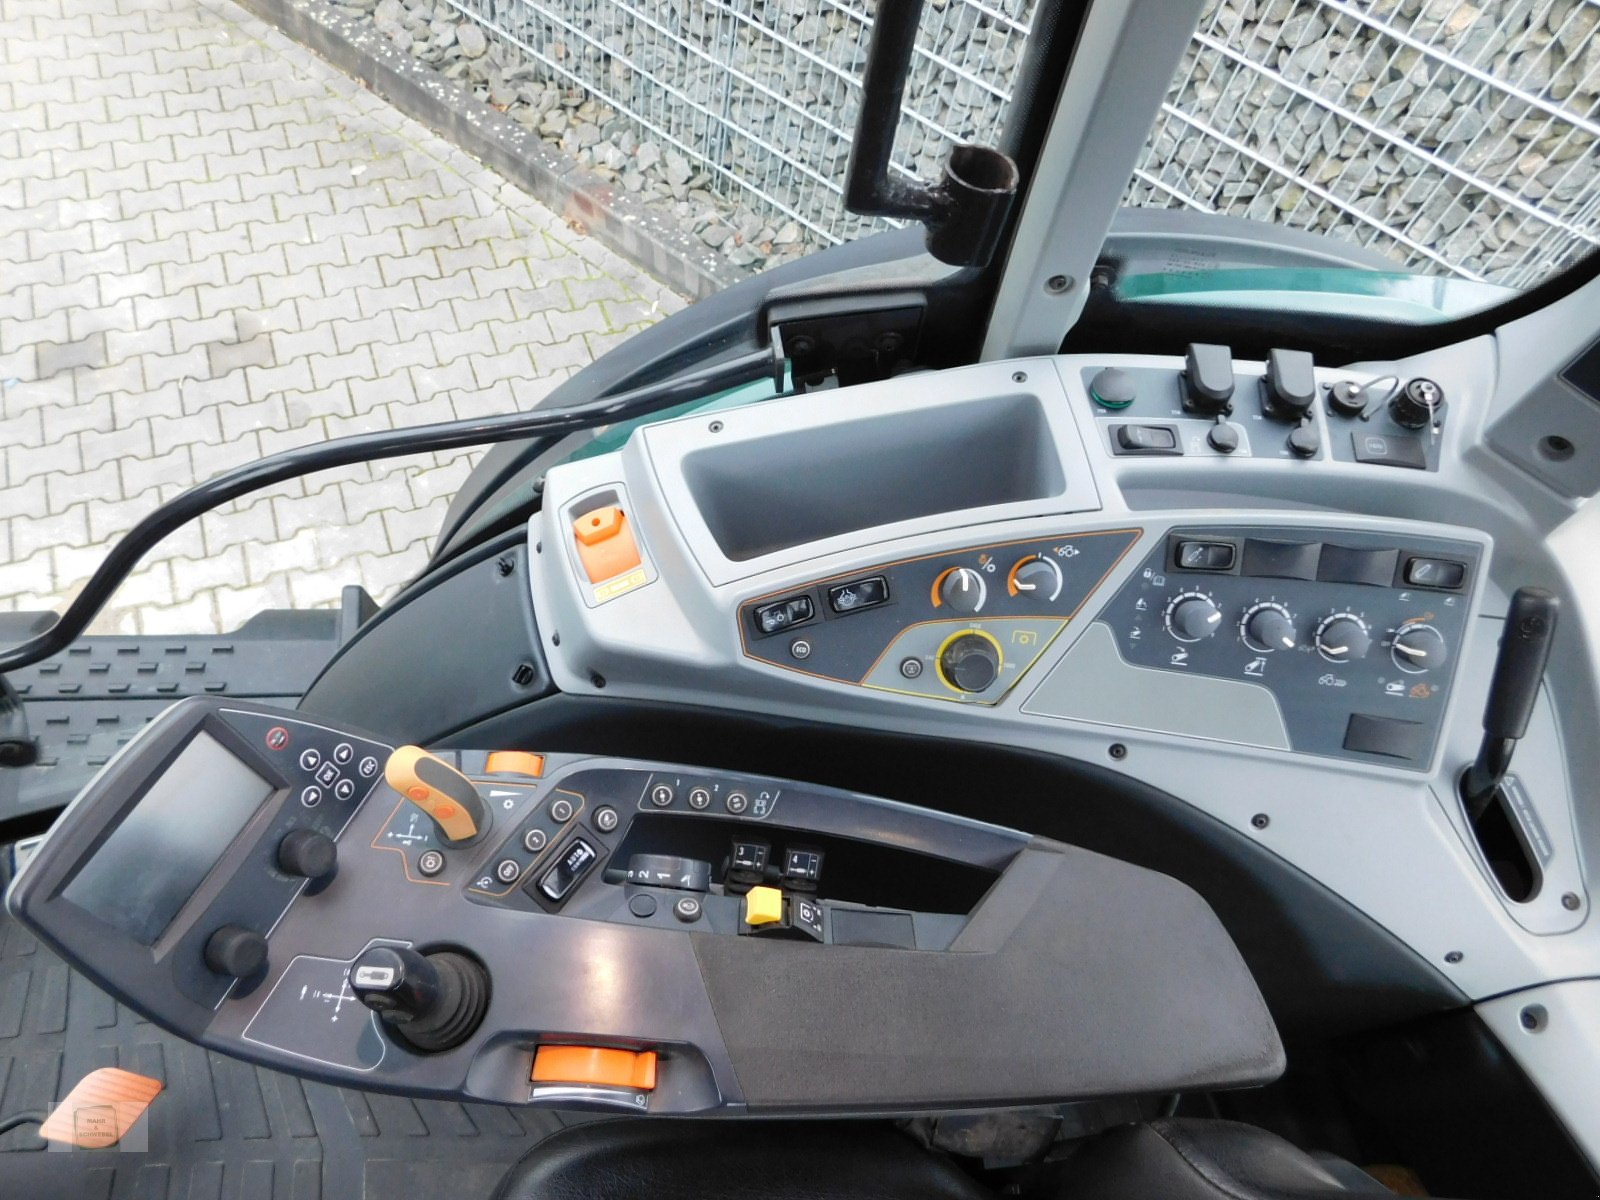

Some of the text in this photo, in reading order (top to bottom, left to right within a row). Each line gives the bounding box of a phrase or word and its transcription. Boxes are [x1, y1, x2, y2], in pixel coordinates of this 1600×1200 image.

[363, 760, 375, 774] ESC
[323, 769, 335, 781] OK
[566, 848, 584, 866] AUTO
[738, 847, 744, 856] 3
[792, 854, 798, 864] 4
[639, 870, 650, 879] 2
[656, 872, 671, 880] 1
